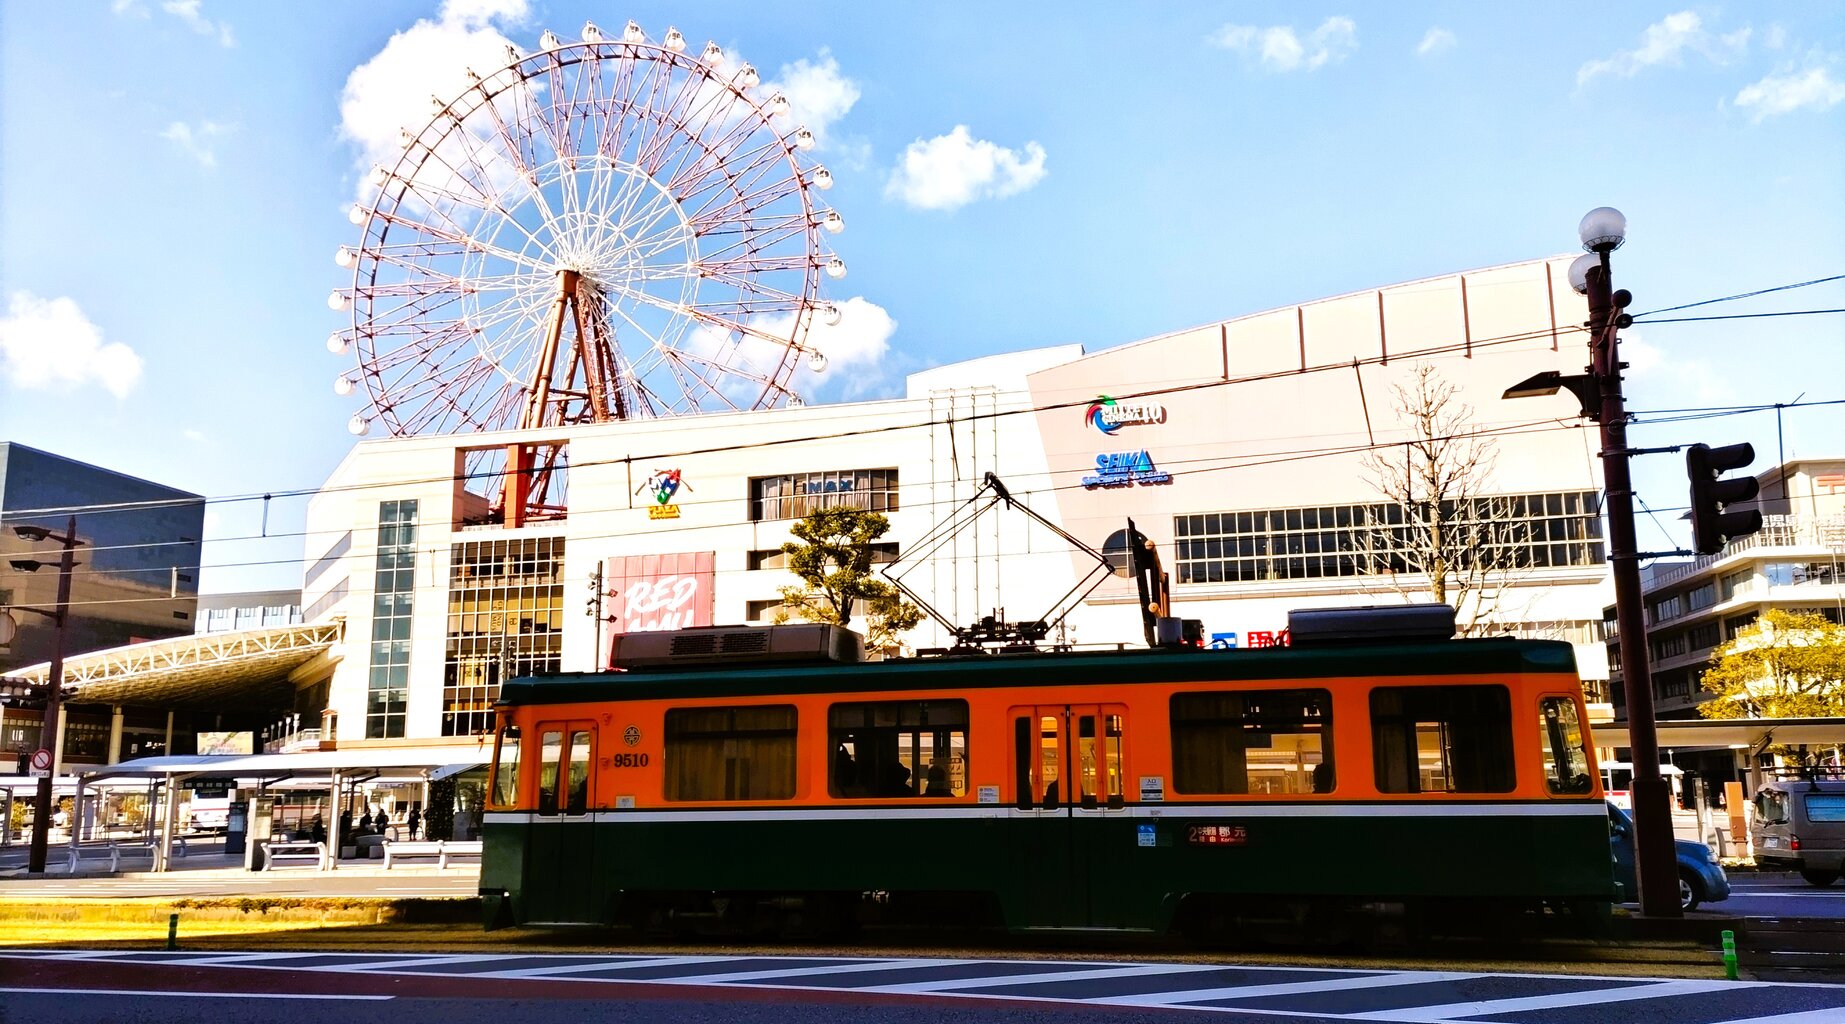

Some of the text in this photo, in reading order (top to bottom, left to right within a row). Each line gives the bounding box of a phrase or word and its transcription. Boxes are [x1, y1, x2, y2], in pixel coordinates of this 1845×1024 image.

[1096, 449, 1153, 474] SEIKA
[624, 575, 697, 619] RED
[614, 753, 649, 767] 9510
[1189, 826, 1198, 842] 2
